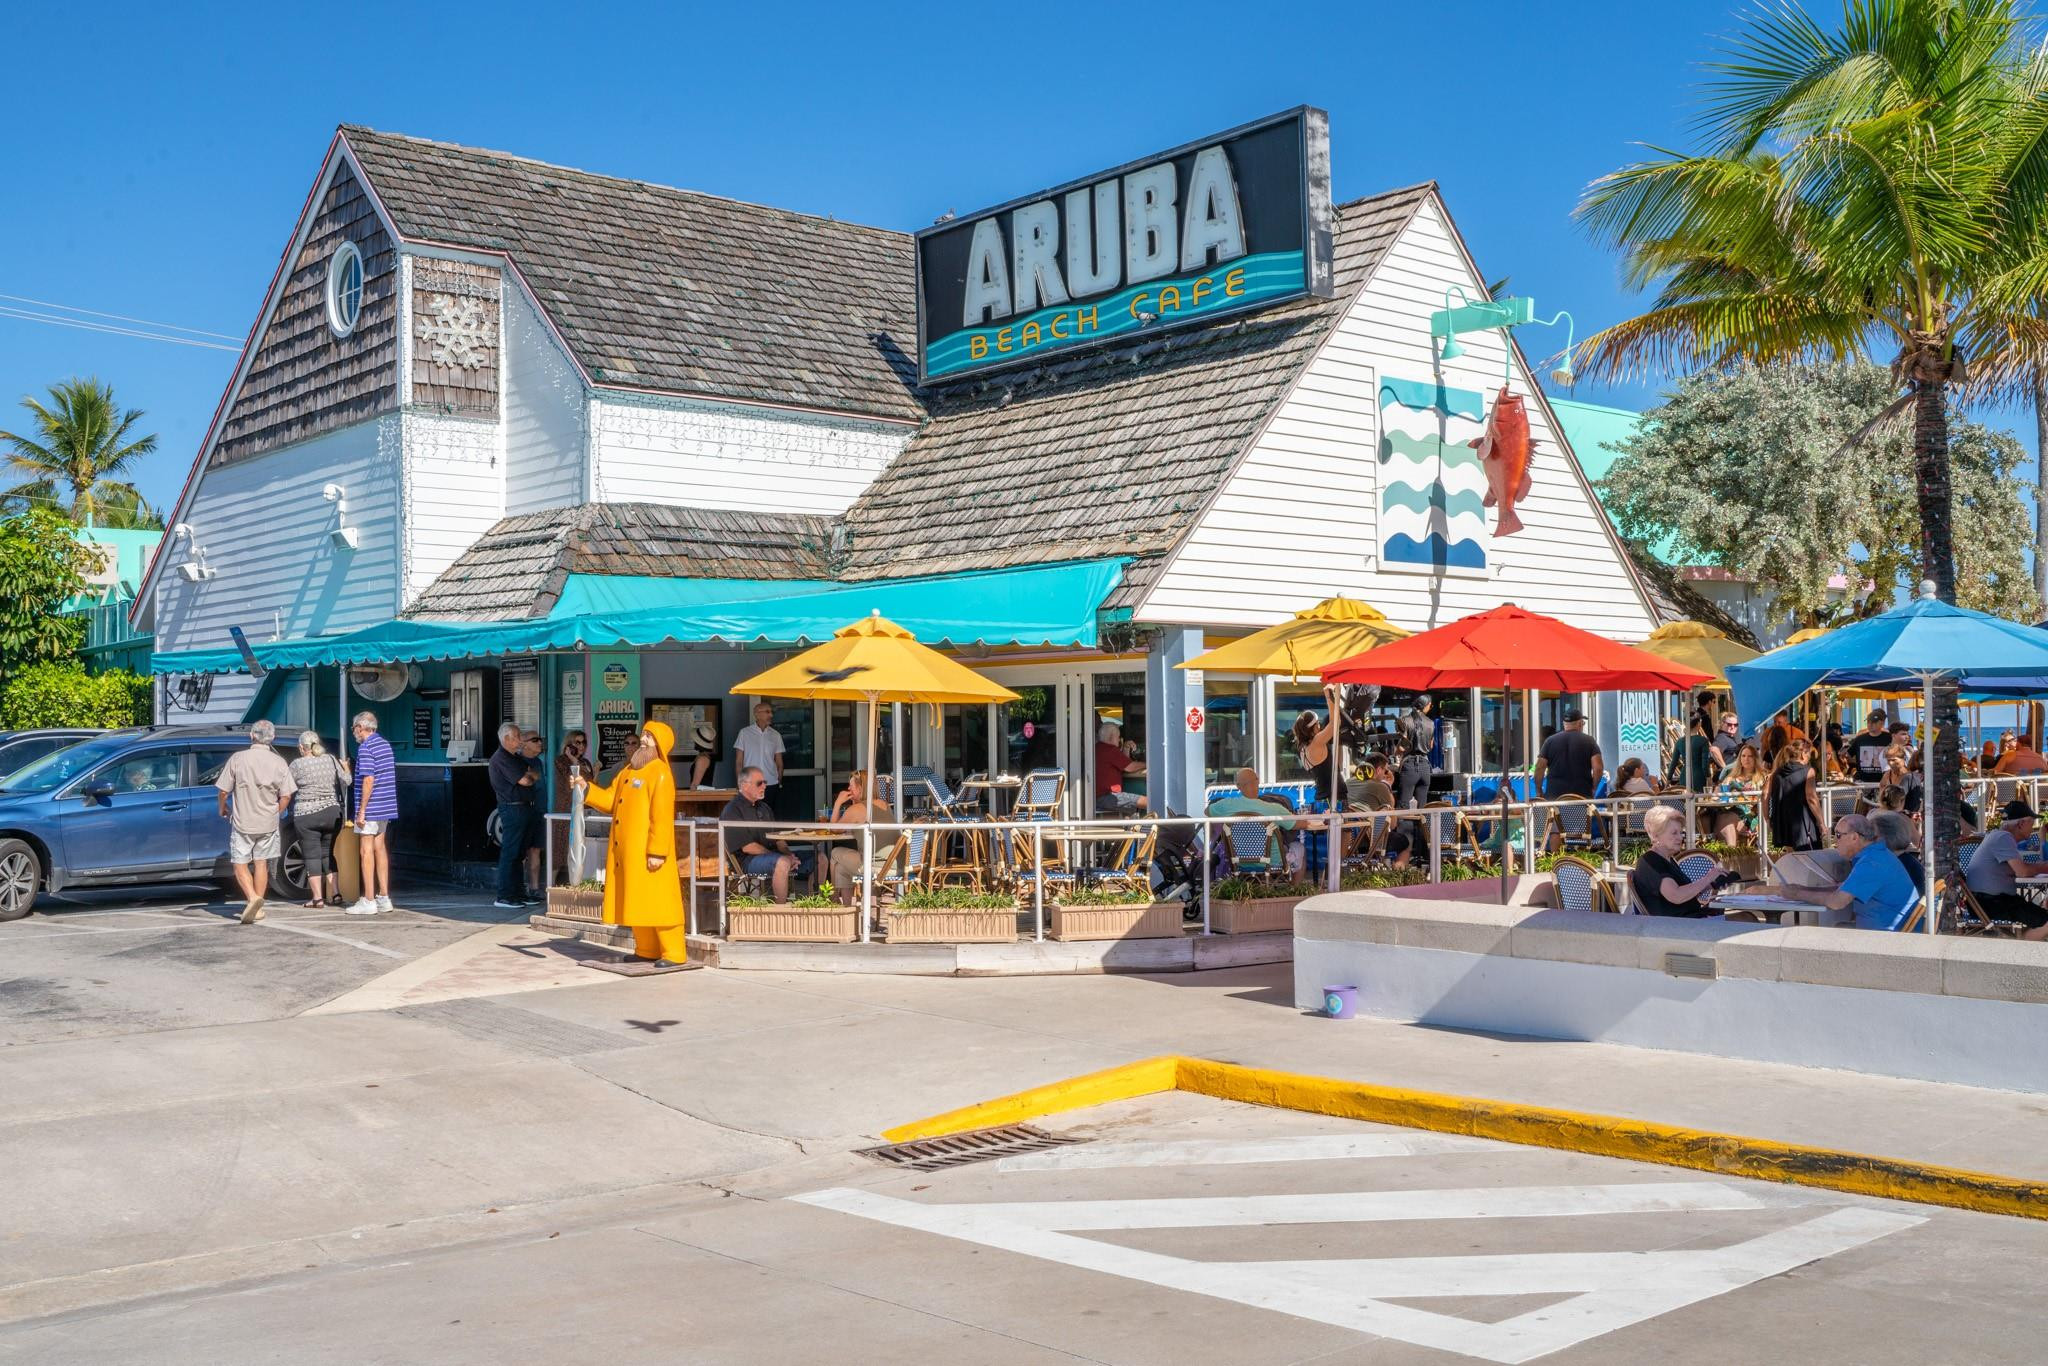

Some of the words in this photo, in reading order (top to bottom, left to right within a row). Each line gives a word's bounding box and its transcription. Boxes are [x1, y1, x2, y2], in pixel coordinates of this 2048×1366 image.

[963, 145, 1248, 327] ARUBA
[970, 305, 1098, 360] BEACH
[1129, 268, 1246, 319] CAFE
[599, 700, 635, 713] ARUBA
[1622, 691, 1656, 724] ARUBA
